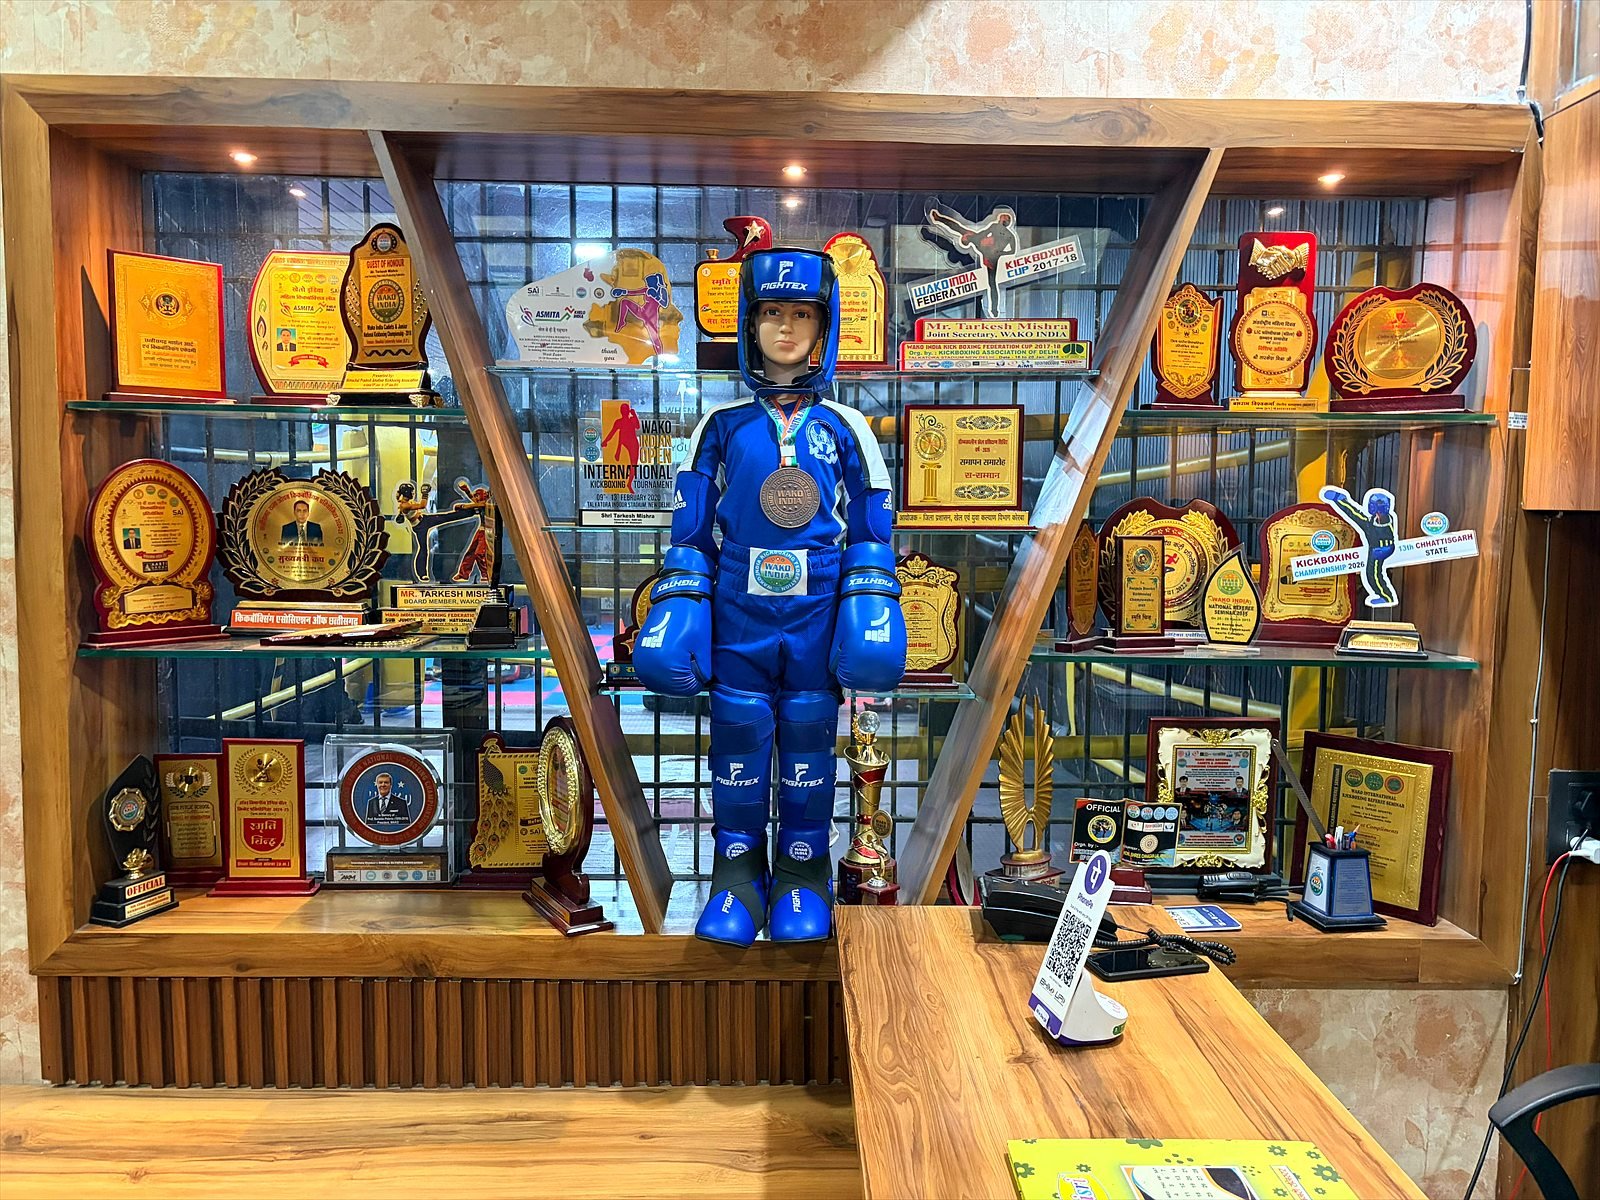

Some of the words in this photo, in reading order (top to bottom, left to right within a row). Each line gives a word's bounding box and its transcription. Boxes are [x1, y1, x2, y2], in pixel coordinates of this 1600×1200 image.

[1005, 244, 1074, 270] KICKBOXING
[367, 261, 380, 269] GUEST
[381, 260, 386, 268] OF
[387, 259, 404, 267] HONOUR
[1007, 266, 1029, 278] CUP
[1032, 254, 1077, 272] 2017-18
[761, 282, 808, 291] FIGHTEX
[917, 282, 978, 307] FEDERATION
[642, 421, 671, 434] WAKO
[640, 435, 672, 448] INDIAN
[640, 448, 672, 464] OPEN
[984, 458, 1006, 466] समारोह
[584, 465, 672, 479] INTERNATIONAL
[591, 481, 626, 489] KICKBOXING
[634, 481, 673, 489] TOURNAMENT
[1416, 534, 1473, 548] CHHATTISGARH
[1425, 547, 1448, 556] STATE
[278, 555, 310, 564] मुख्यमंत्री
[1297, 552, 1359, 568] KICKBOXING
[765, 563, 791, 571] WAKO
[1295, 564, 1346, 577] CHAMPIONSHIP
[1348, 561, 1365, 569] 2026
[765, 571, 790, 579] INDIA
[657, 580, 700, 593] FIGHTEX
[849, 578, 894, 588] FIGHTEX
[235, 613, 274, 624] किकबॉक्सिंग
[276, 613, 311, 625] एसोसिएशन
[312, 614, 327, 625] ऑफ
[716, 776, 760, 787] FIGHTEX
[782, 777, 824, 788] FIGHTEX
[1364, 791, 1397, 801] INTERNATIONAL
[1086, 804, 1120, 813] OFFICIAL
[1386, 801, 1405, 809] SEMINAR
[1366, 822, 1399, 834] Compliments
[127, 878, 164, 896] OFFICIAL
[1077, 892, 1094, 910] PhonePe
[1055, 992, 1066, 1004] UPI
